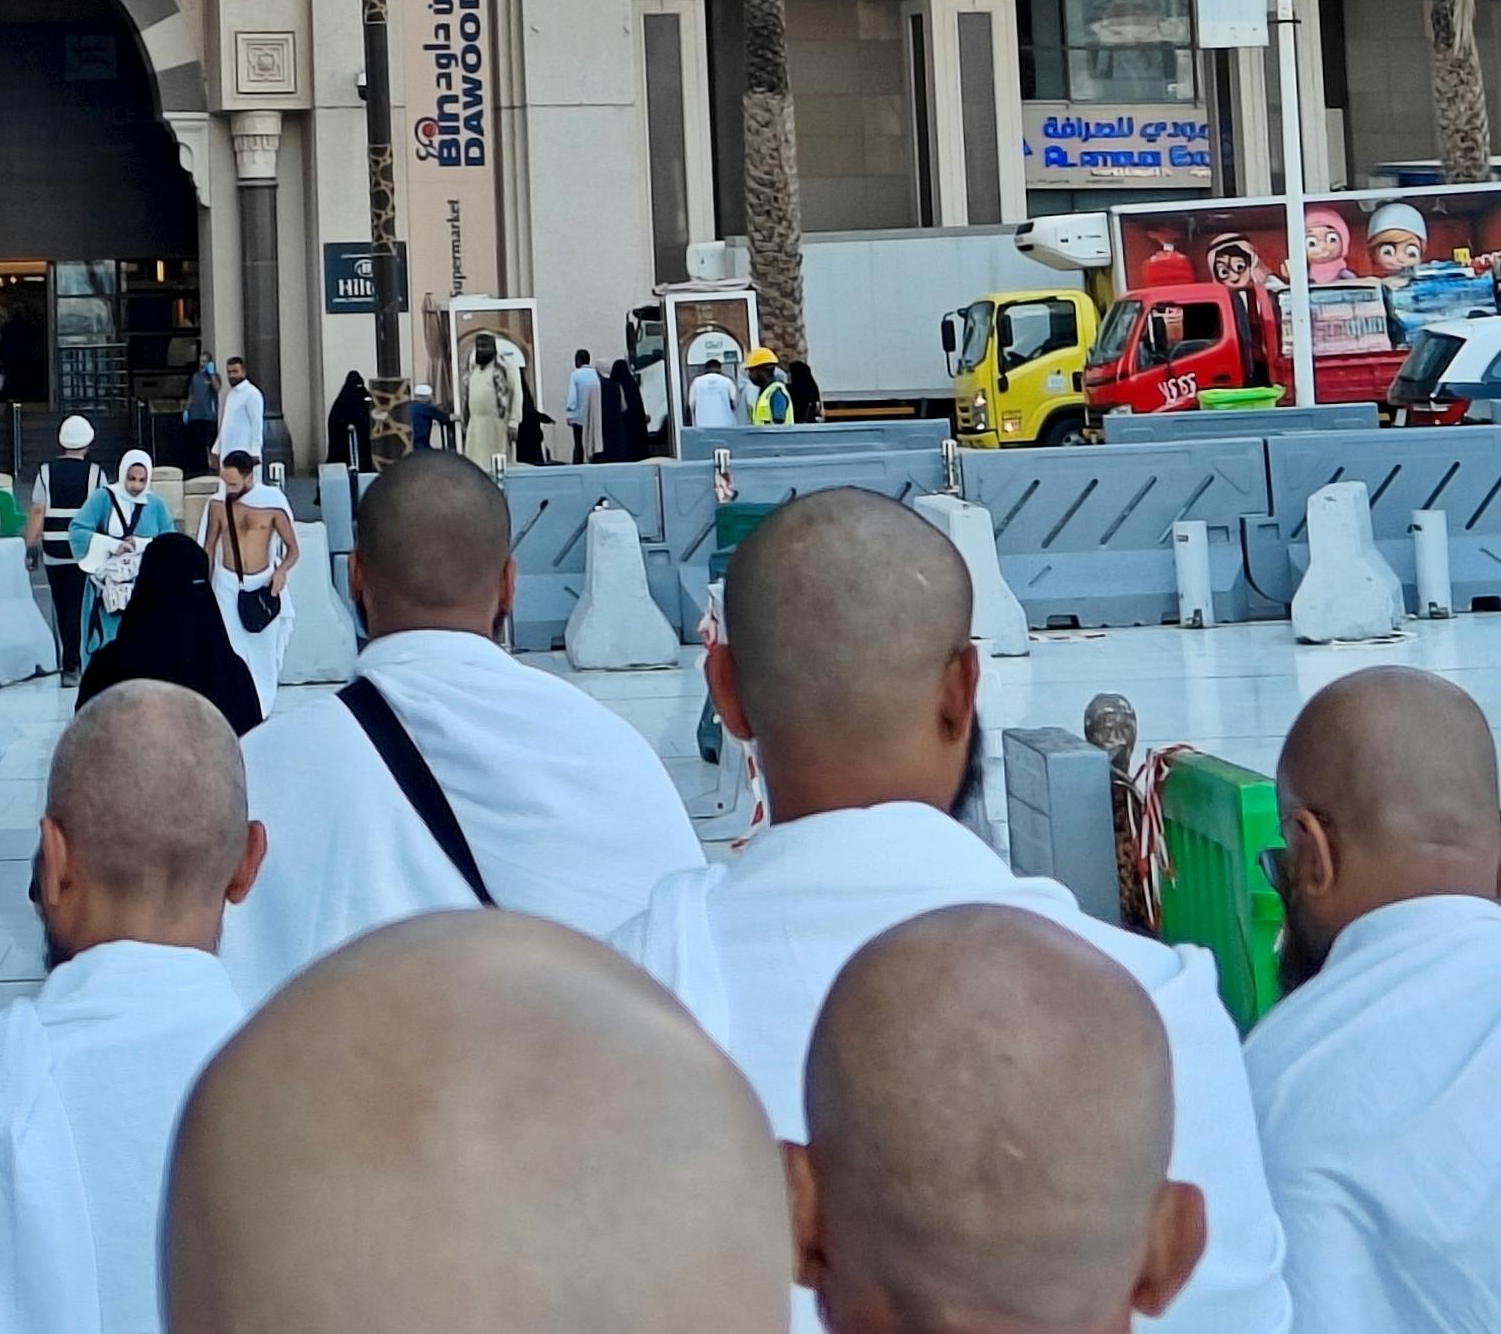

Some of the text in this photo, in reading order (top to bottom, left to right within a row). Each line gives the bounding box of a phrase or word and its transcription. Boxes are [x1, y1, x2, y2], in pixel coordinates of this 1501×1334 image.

[1042, 117, 1134, 142] للصرافة
[446, 199, 467, 298] Supermarket
[338, 279, 375, 296] Hilt
